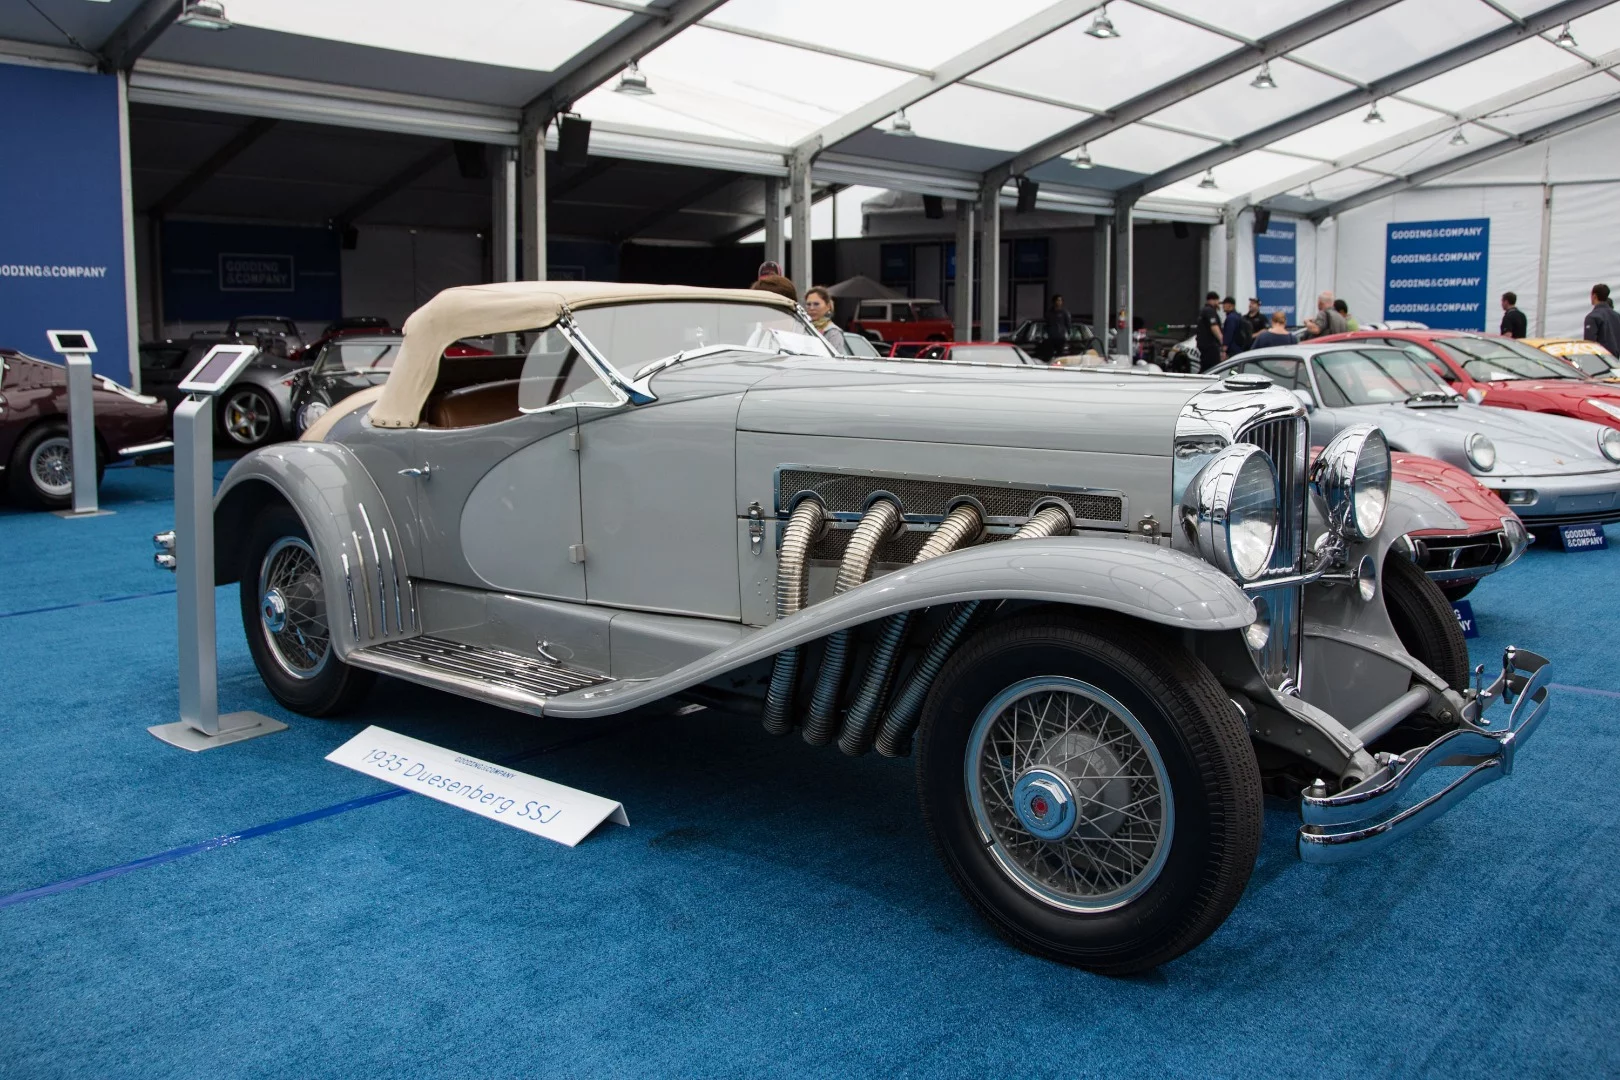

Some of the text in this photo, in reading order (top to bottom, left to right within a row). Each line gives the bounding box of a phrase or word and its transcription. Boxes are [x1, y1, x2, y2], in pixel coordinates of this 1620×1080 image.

[1391, 227, 1483, 239] GOODING&COMPANY
[1391, 252, 1482, 264] GOODING&COMPANY
[0, 264, 107, 278] ODING&COMPANY
[225, 261, 279, 272] GOODING
[226, 273, 288, 284] &COMPANY
[1389, 277, 1481, 288] GOODING&COMPANY
[1388, 303, 1479, 313] GOODING&COMPANY
[1565, 528, 1597, 539] GOODING
[1567, 536, 1603, 548] &COMPANY
[361, 747, 563, 825] 1935 Duesenberg SSJ
